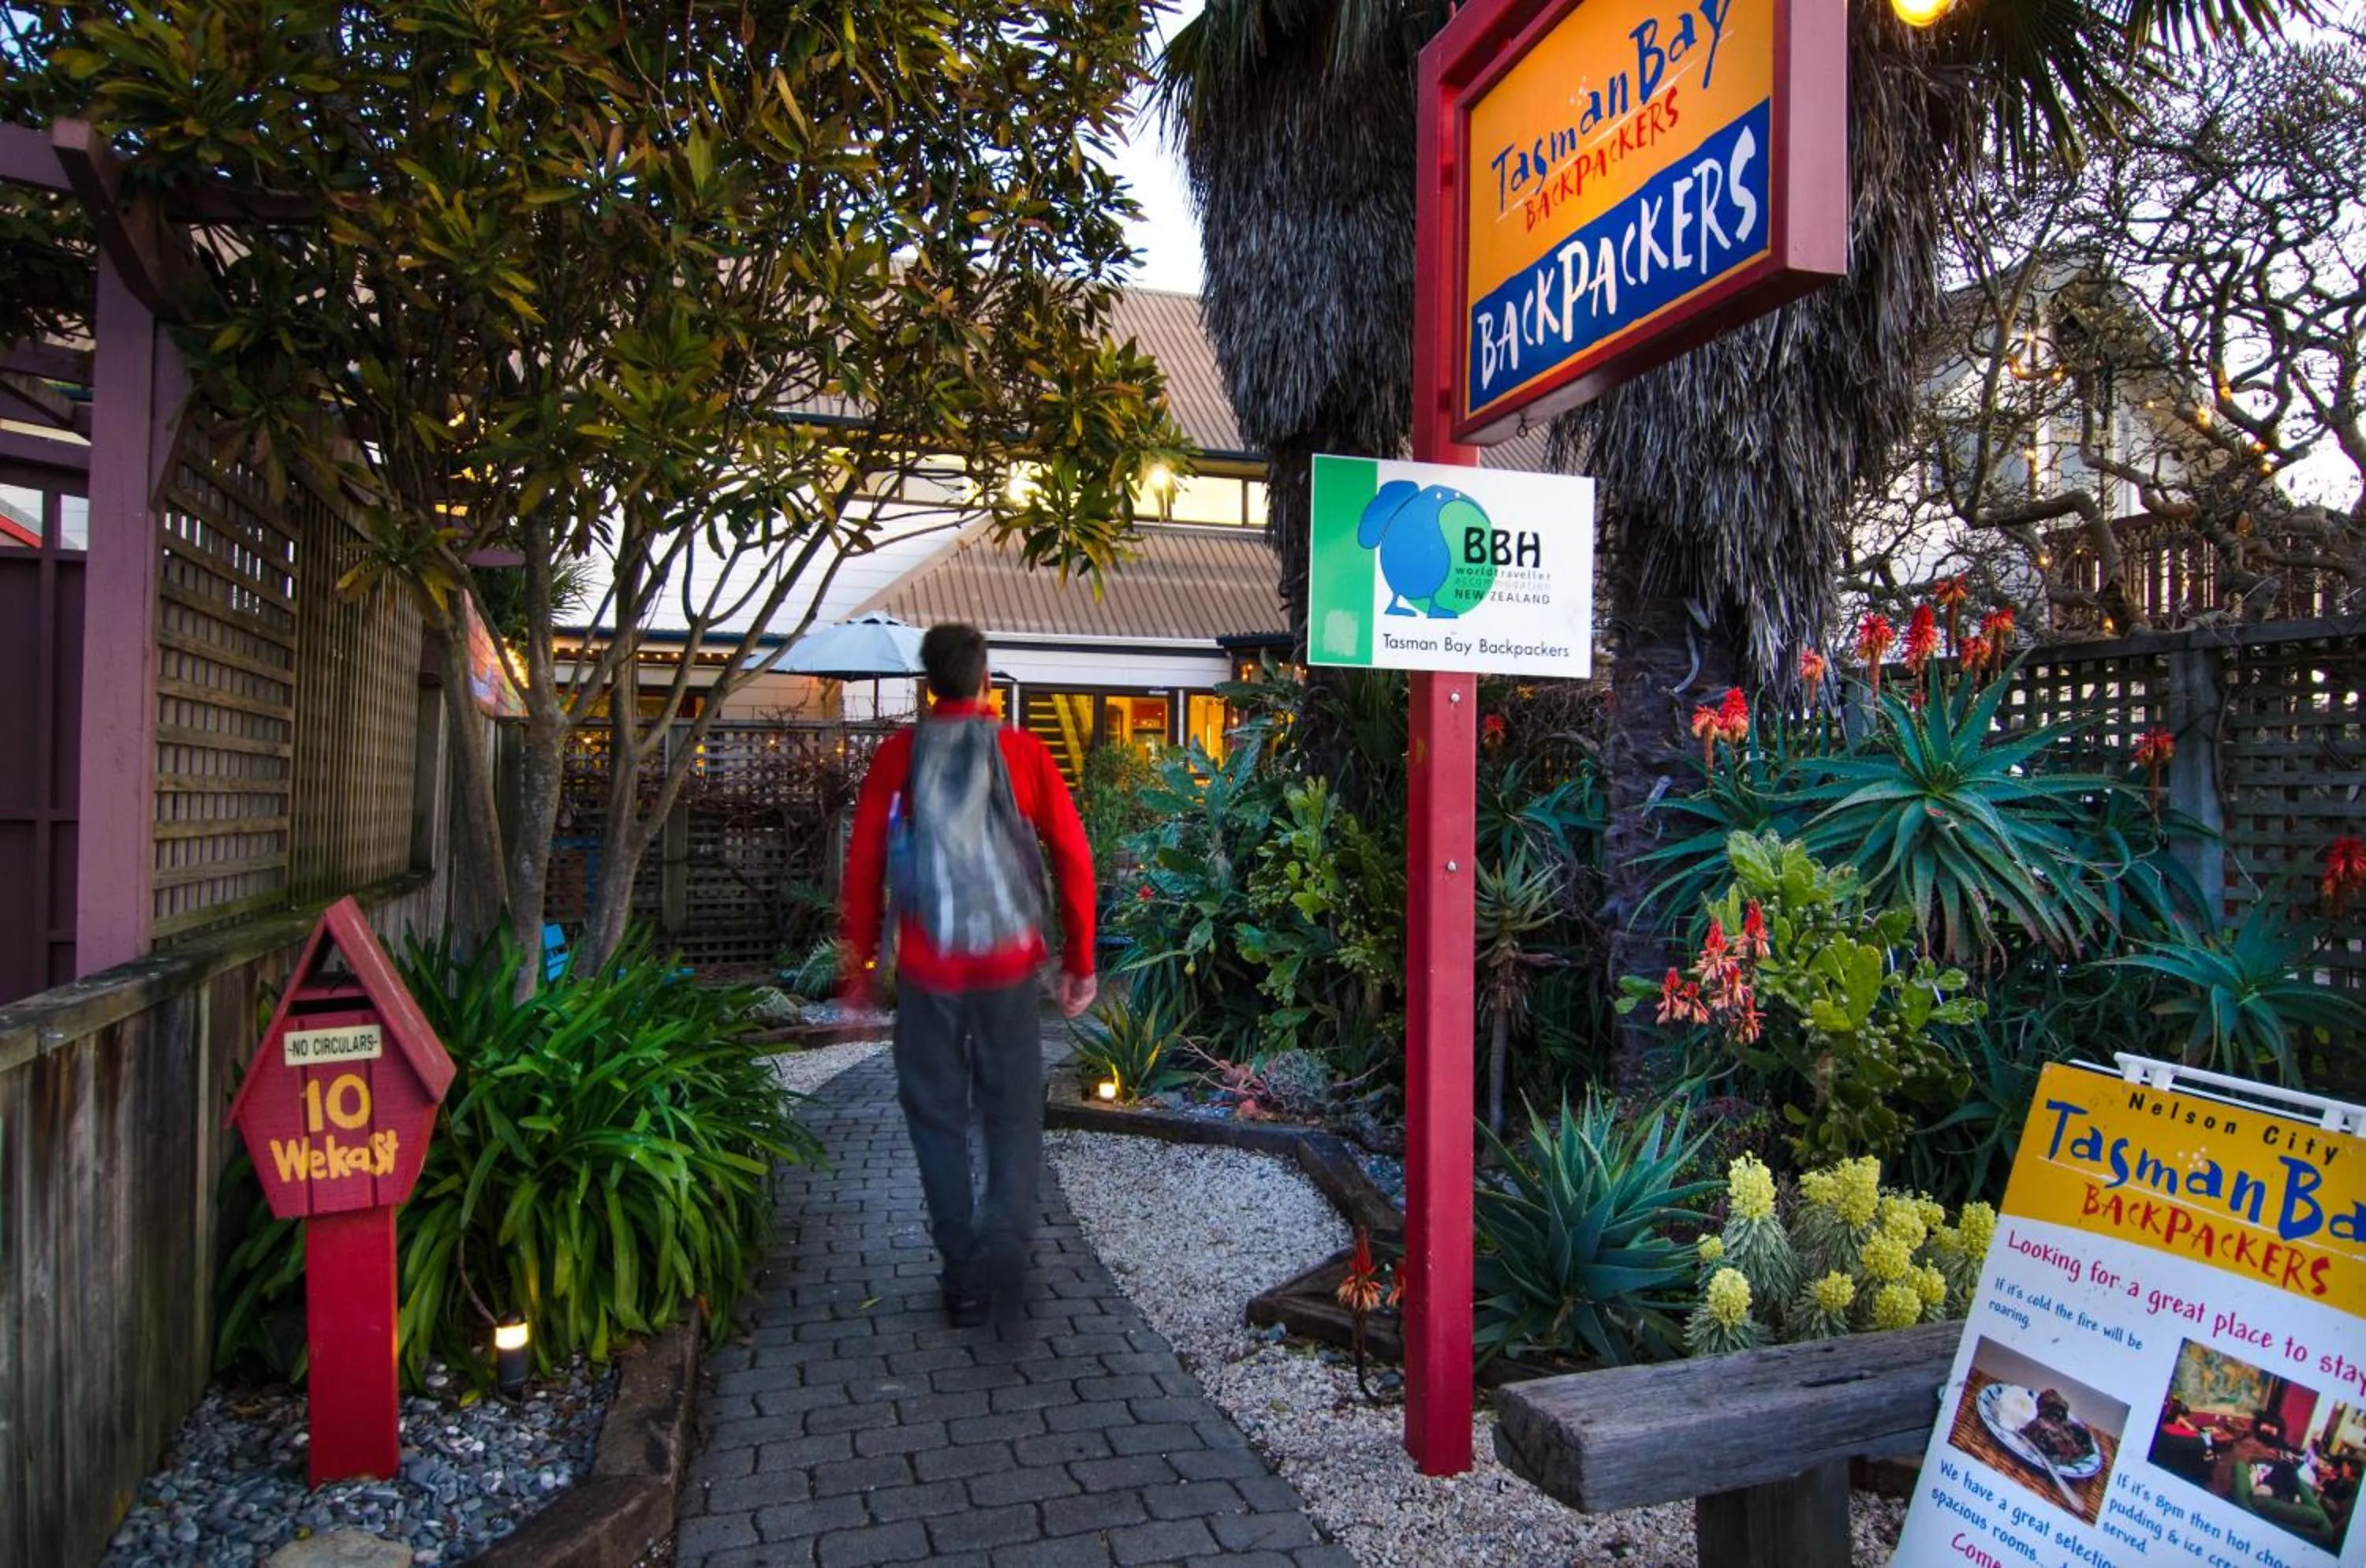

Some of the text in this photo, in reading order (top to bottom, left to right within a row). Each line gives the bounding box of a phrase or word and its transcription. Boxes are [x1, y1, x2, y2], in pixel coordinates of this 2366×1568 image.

[1491, 0, 1730, 211] Tasman Bay
[1525, 86, 1678, 233] BACKPACKERS
[1477, 125, 1756, 390] BACKPACKERS
[1465, 526, 1540, 568] BBH
[1454, 589, 1551, 605] NEW ZEALAND
[1383, 633, 1569, 659] Tasman Bay Backpackers
[307, 1073, 371, 1132] 10
[2129, 1092, 2339, 1166] Nelson City
[2046, 1099, 2267, 1223] Tasman
[2083, 1182, 2331, 1296] BACKPACKERS
[1995, 1276, 2143, 1350] If it's cold the fire will be
[2008, 1230, 2081, 1283] Looking
[2091, 1260, 2121, 1288] for
[2127, 1281, 2140, 1297] a
[2147, 1290, 2206, 1323] great
[2212, 1312, 2273, 1347] place
[2284, 1337, 2308, 1362] to
[1931, 1488, 1987, 1530] spacious
[1940, 1459, 2118, 1568] We have a great selectio
[2108, 1499, 2239, 1568] pudding & ice cre
[2117, 1472, 2292, 1568] If it's 8pm then hot cho
